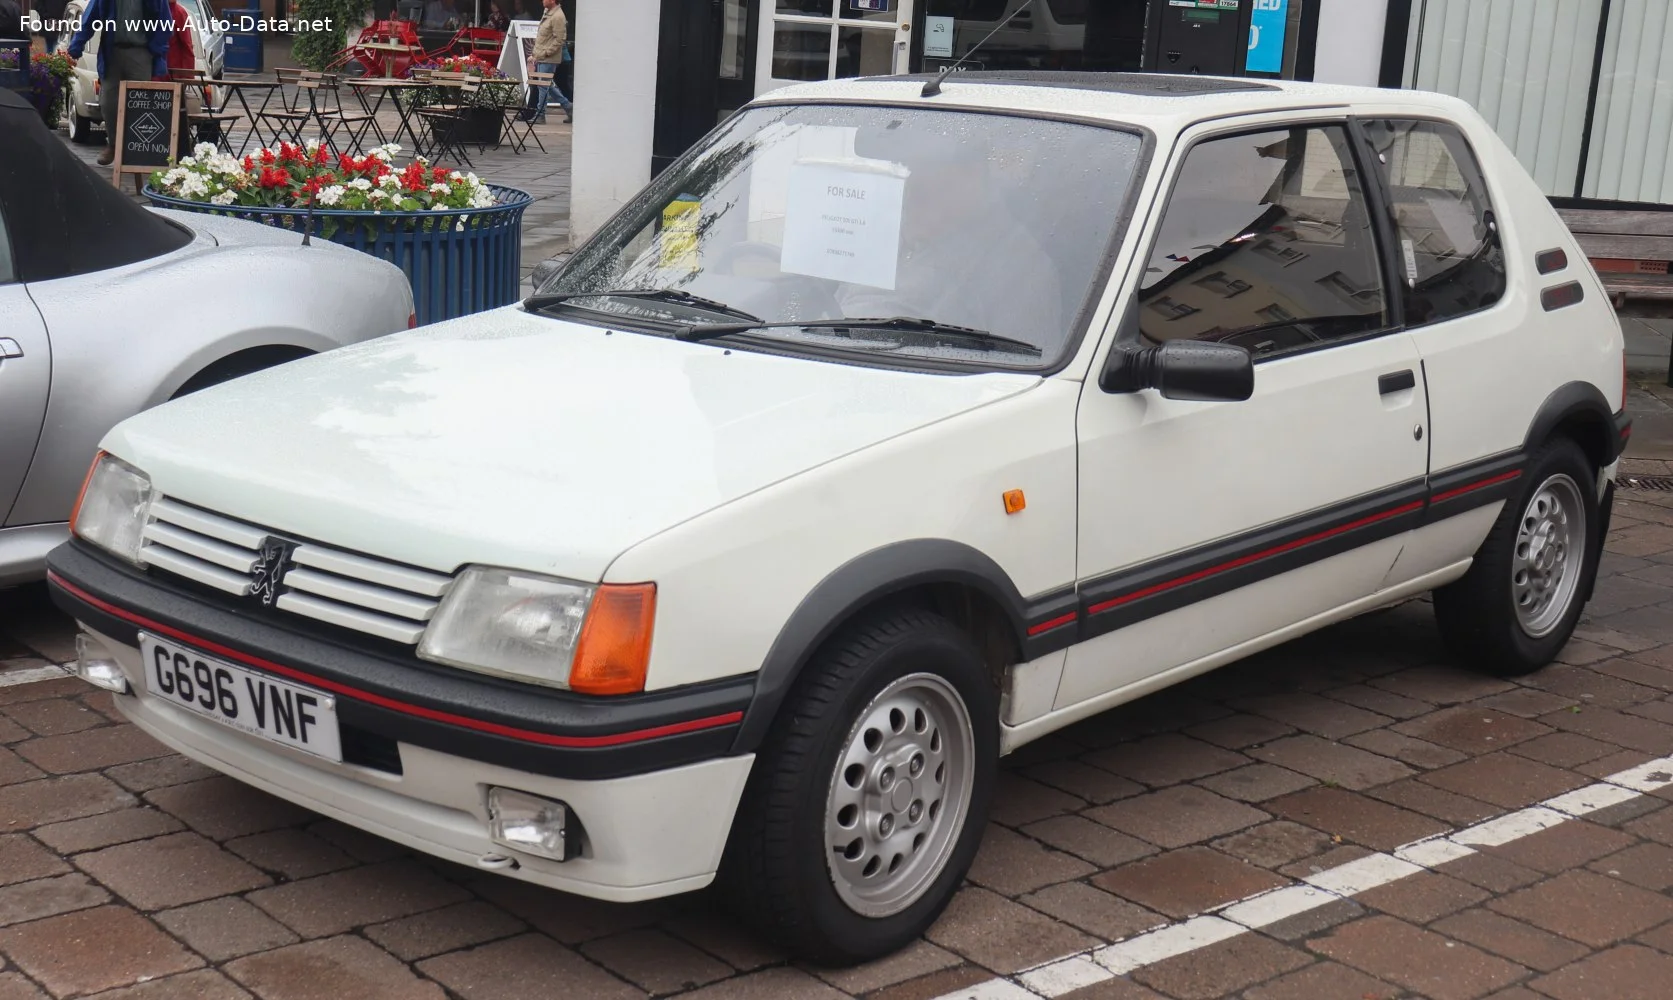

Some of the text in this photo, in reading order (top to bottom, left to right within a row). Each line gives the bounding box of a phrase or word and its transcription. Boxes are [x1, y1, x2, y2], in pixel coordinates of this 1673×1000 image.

[128, 90, 171, 100] CAKE AND
[127, 100, 172, 110] COFFEE SHOP
[127, 142, 170, 154] OPEN NOW
[827, 186, 866, 200] FOR SALE
[154, 645, 318, 744] G696 VNF
